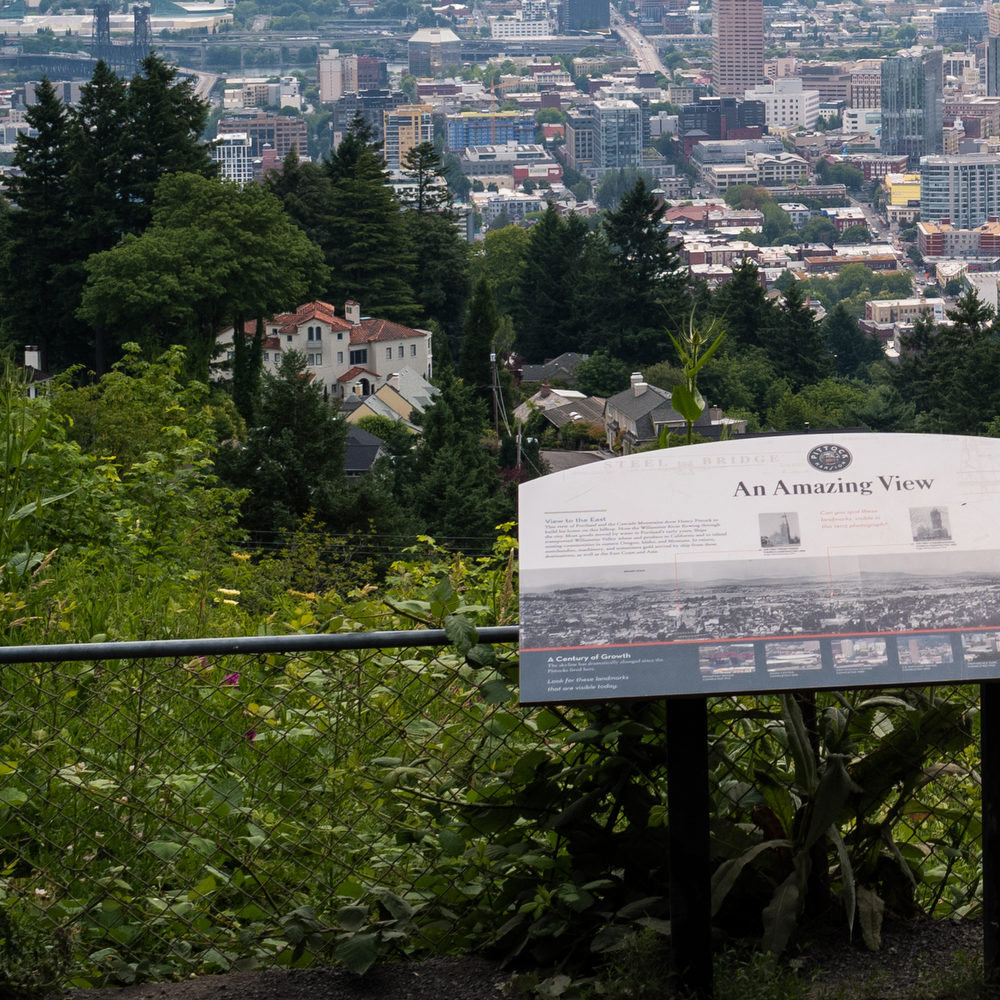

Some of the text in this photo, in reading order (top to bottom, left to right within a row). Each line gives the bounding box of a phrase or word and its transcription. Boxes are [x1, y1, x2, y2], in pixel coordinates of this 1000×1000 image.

[604, 455, 779, 471] STEEL BRIDGE
[733, 475, 934, 497] An Amazing View
[556, 656, 589, 664] Century
